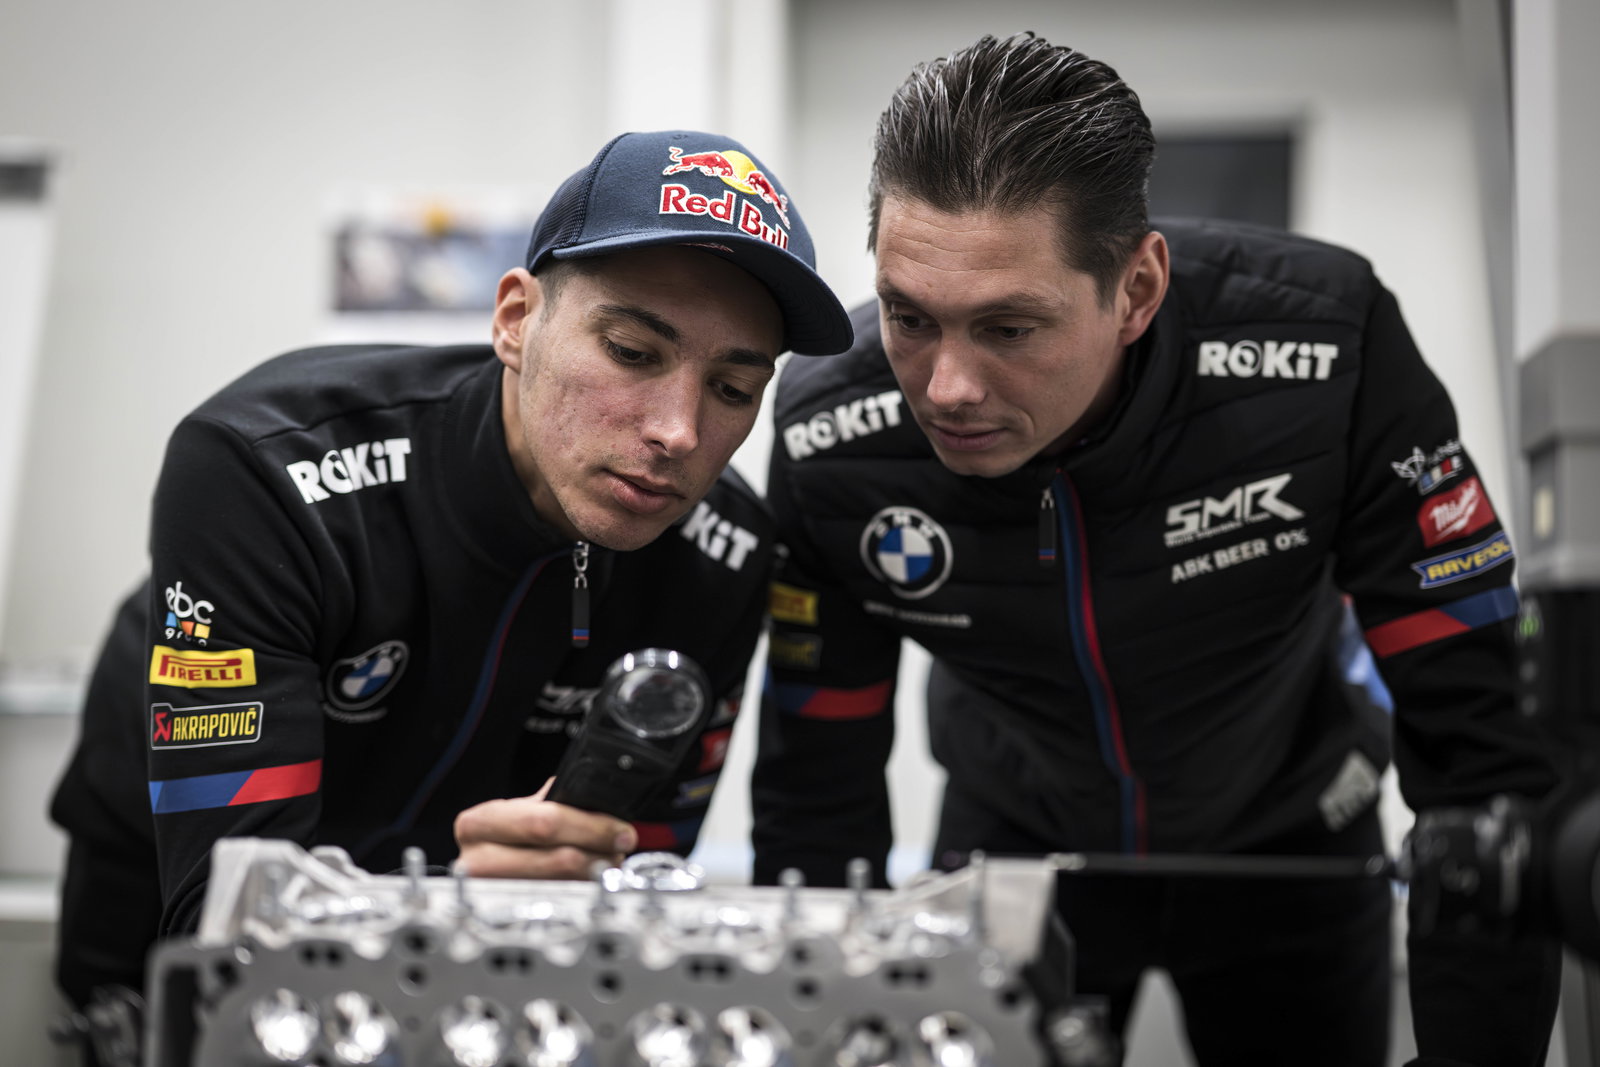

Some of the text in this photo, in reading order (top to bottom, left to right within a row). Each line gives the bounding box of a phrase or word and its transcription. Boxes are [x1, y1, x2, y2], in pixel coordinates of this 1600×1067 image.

[660, 184, 789, 250] Red Bull
[681, 501, 759, 571] KiT
[1171, 554, 1214, 584] ABK
[1213, 538, 1270, 569] BEER
[165, 581, 214, 624] ebc
[158, 655, 243, 682] PIRELLI
